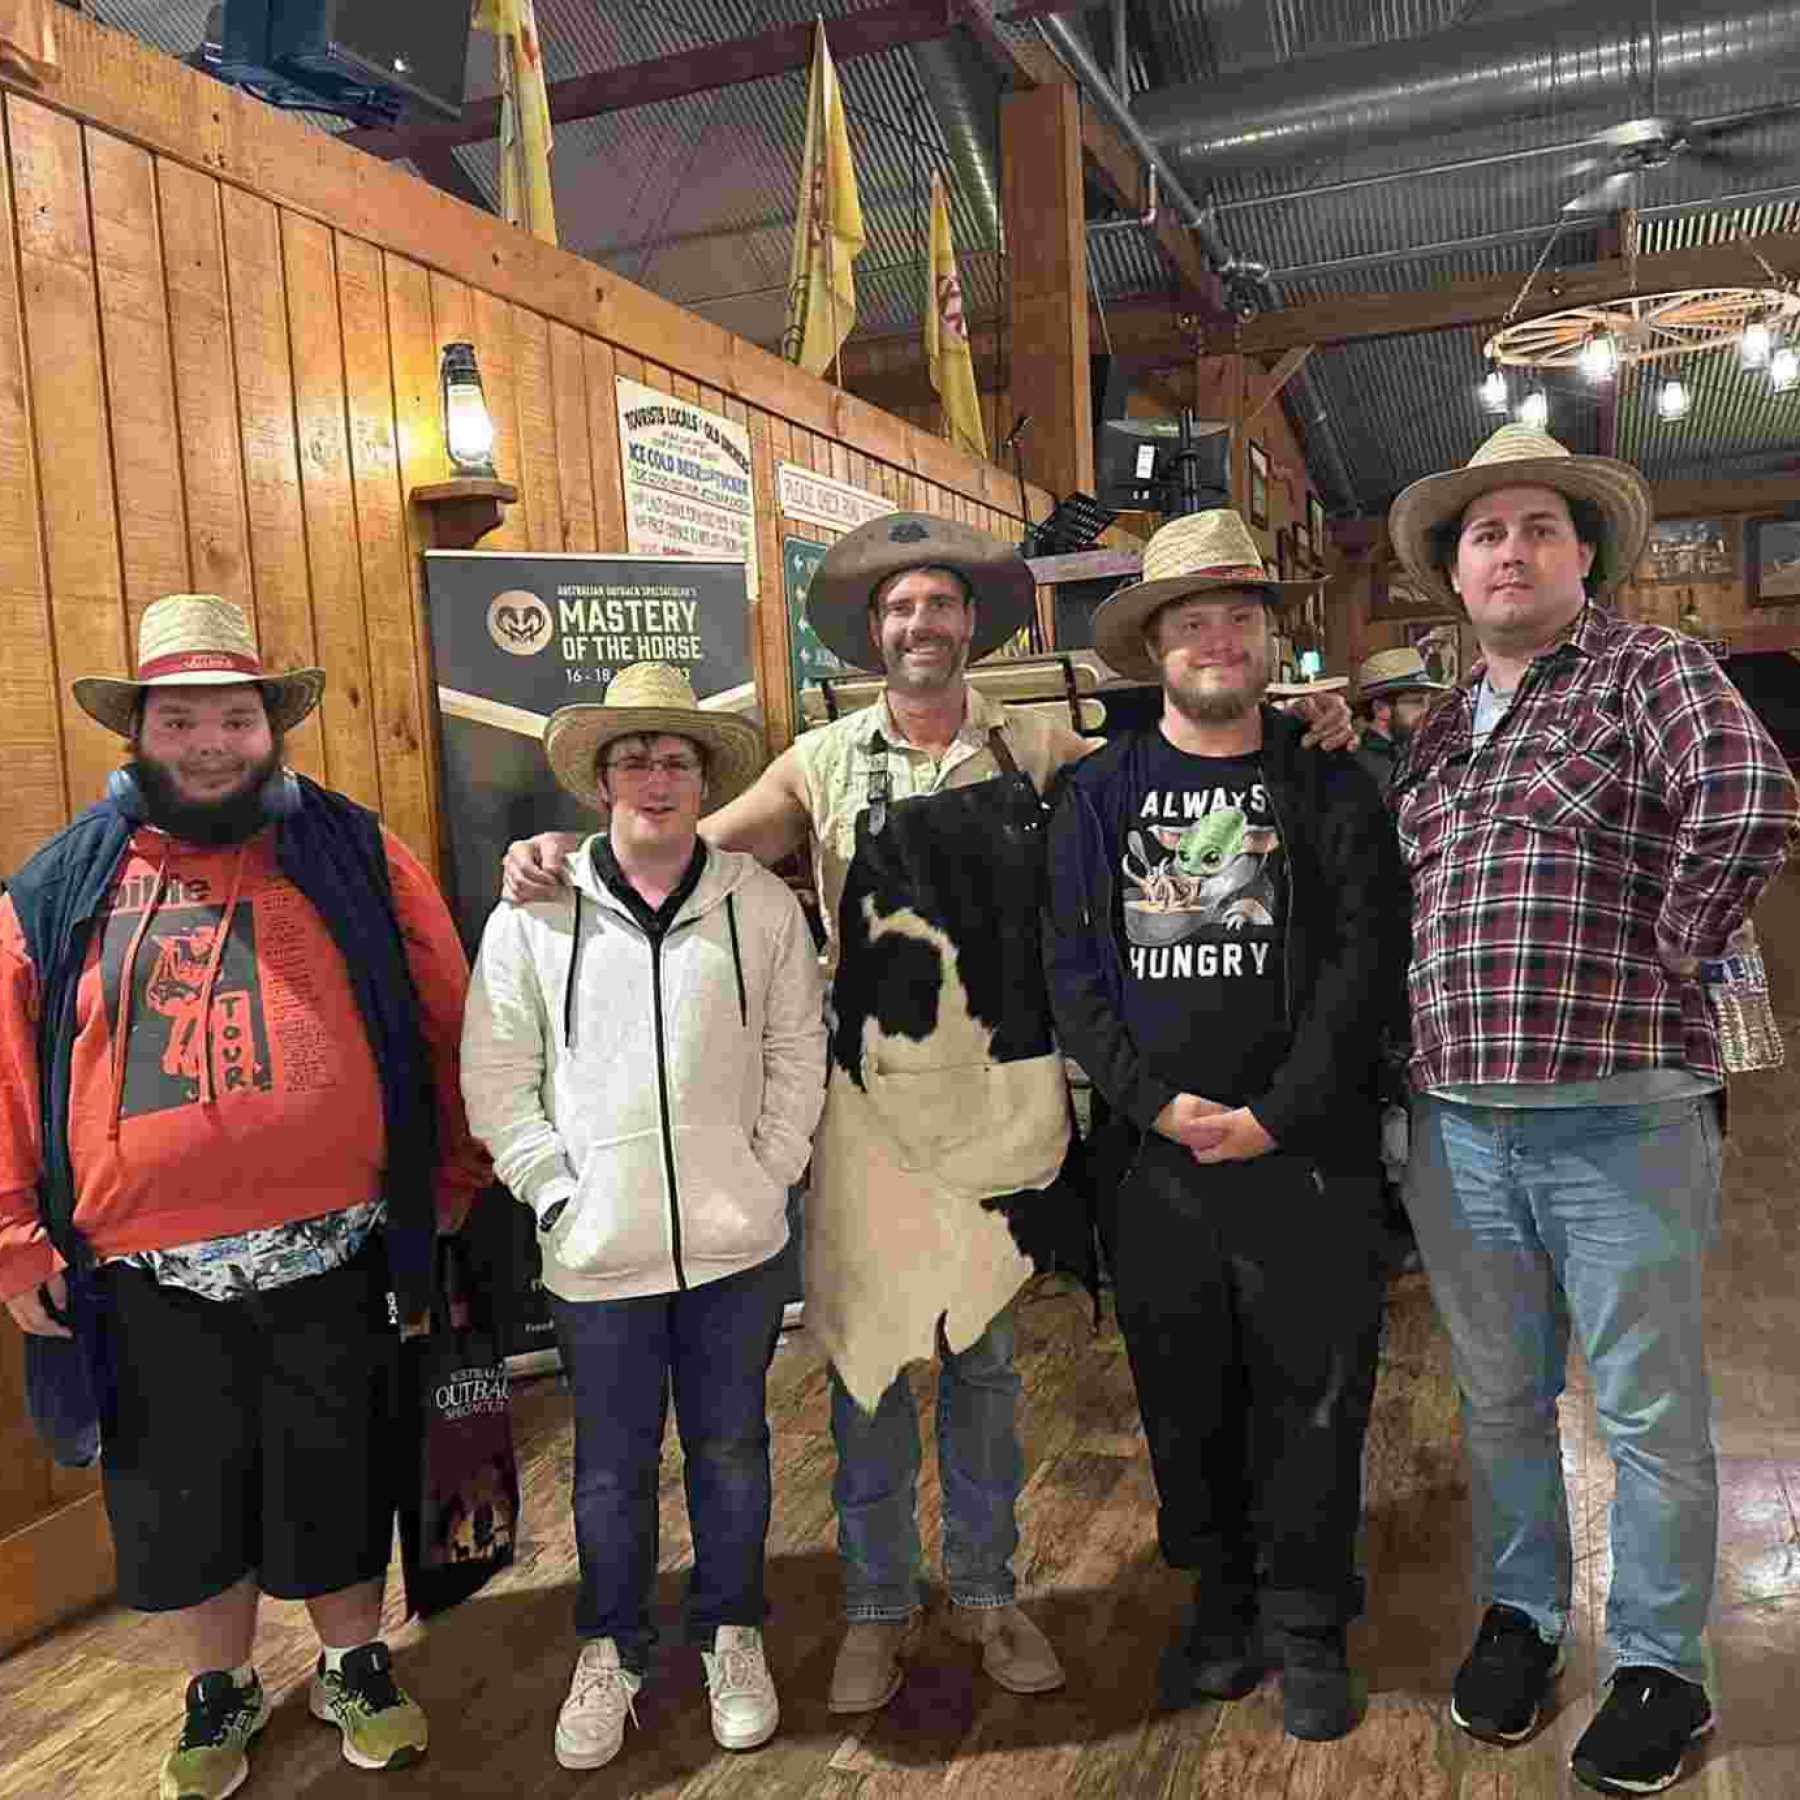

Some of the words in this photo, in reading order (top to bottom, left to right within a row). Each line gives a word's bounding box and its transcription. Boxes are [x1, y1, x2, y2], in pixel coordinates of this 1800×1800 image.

[647, 448, 674, 472] COLD
[558, 598, 698, 633] MASTERY
[563, 637, 590, 660] OF
[595, 637, 634, 660] THE
[637, 635, 703, 660] HORSE
[566, 668, 582, 683] 16
[1140, 784, 1267, 818] ALWAYS
[1129, 942, 1270, 980] HUNGRY
